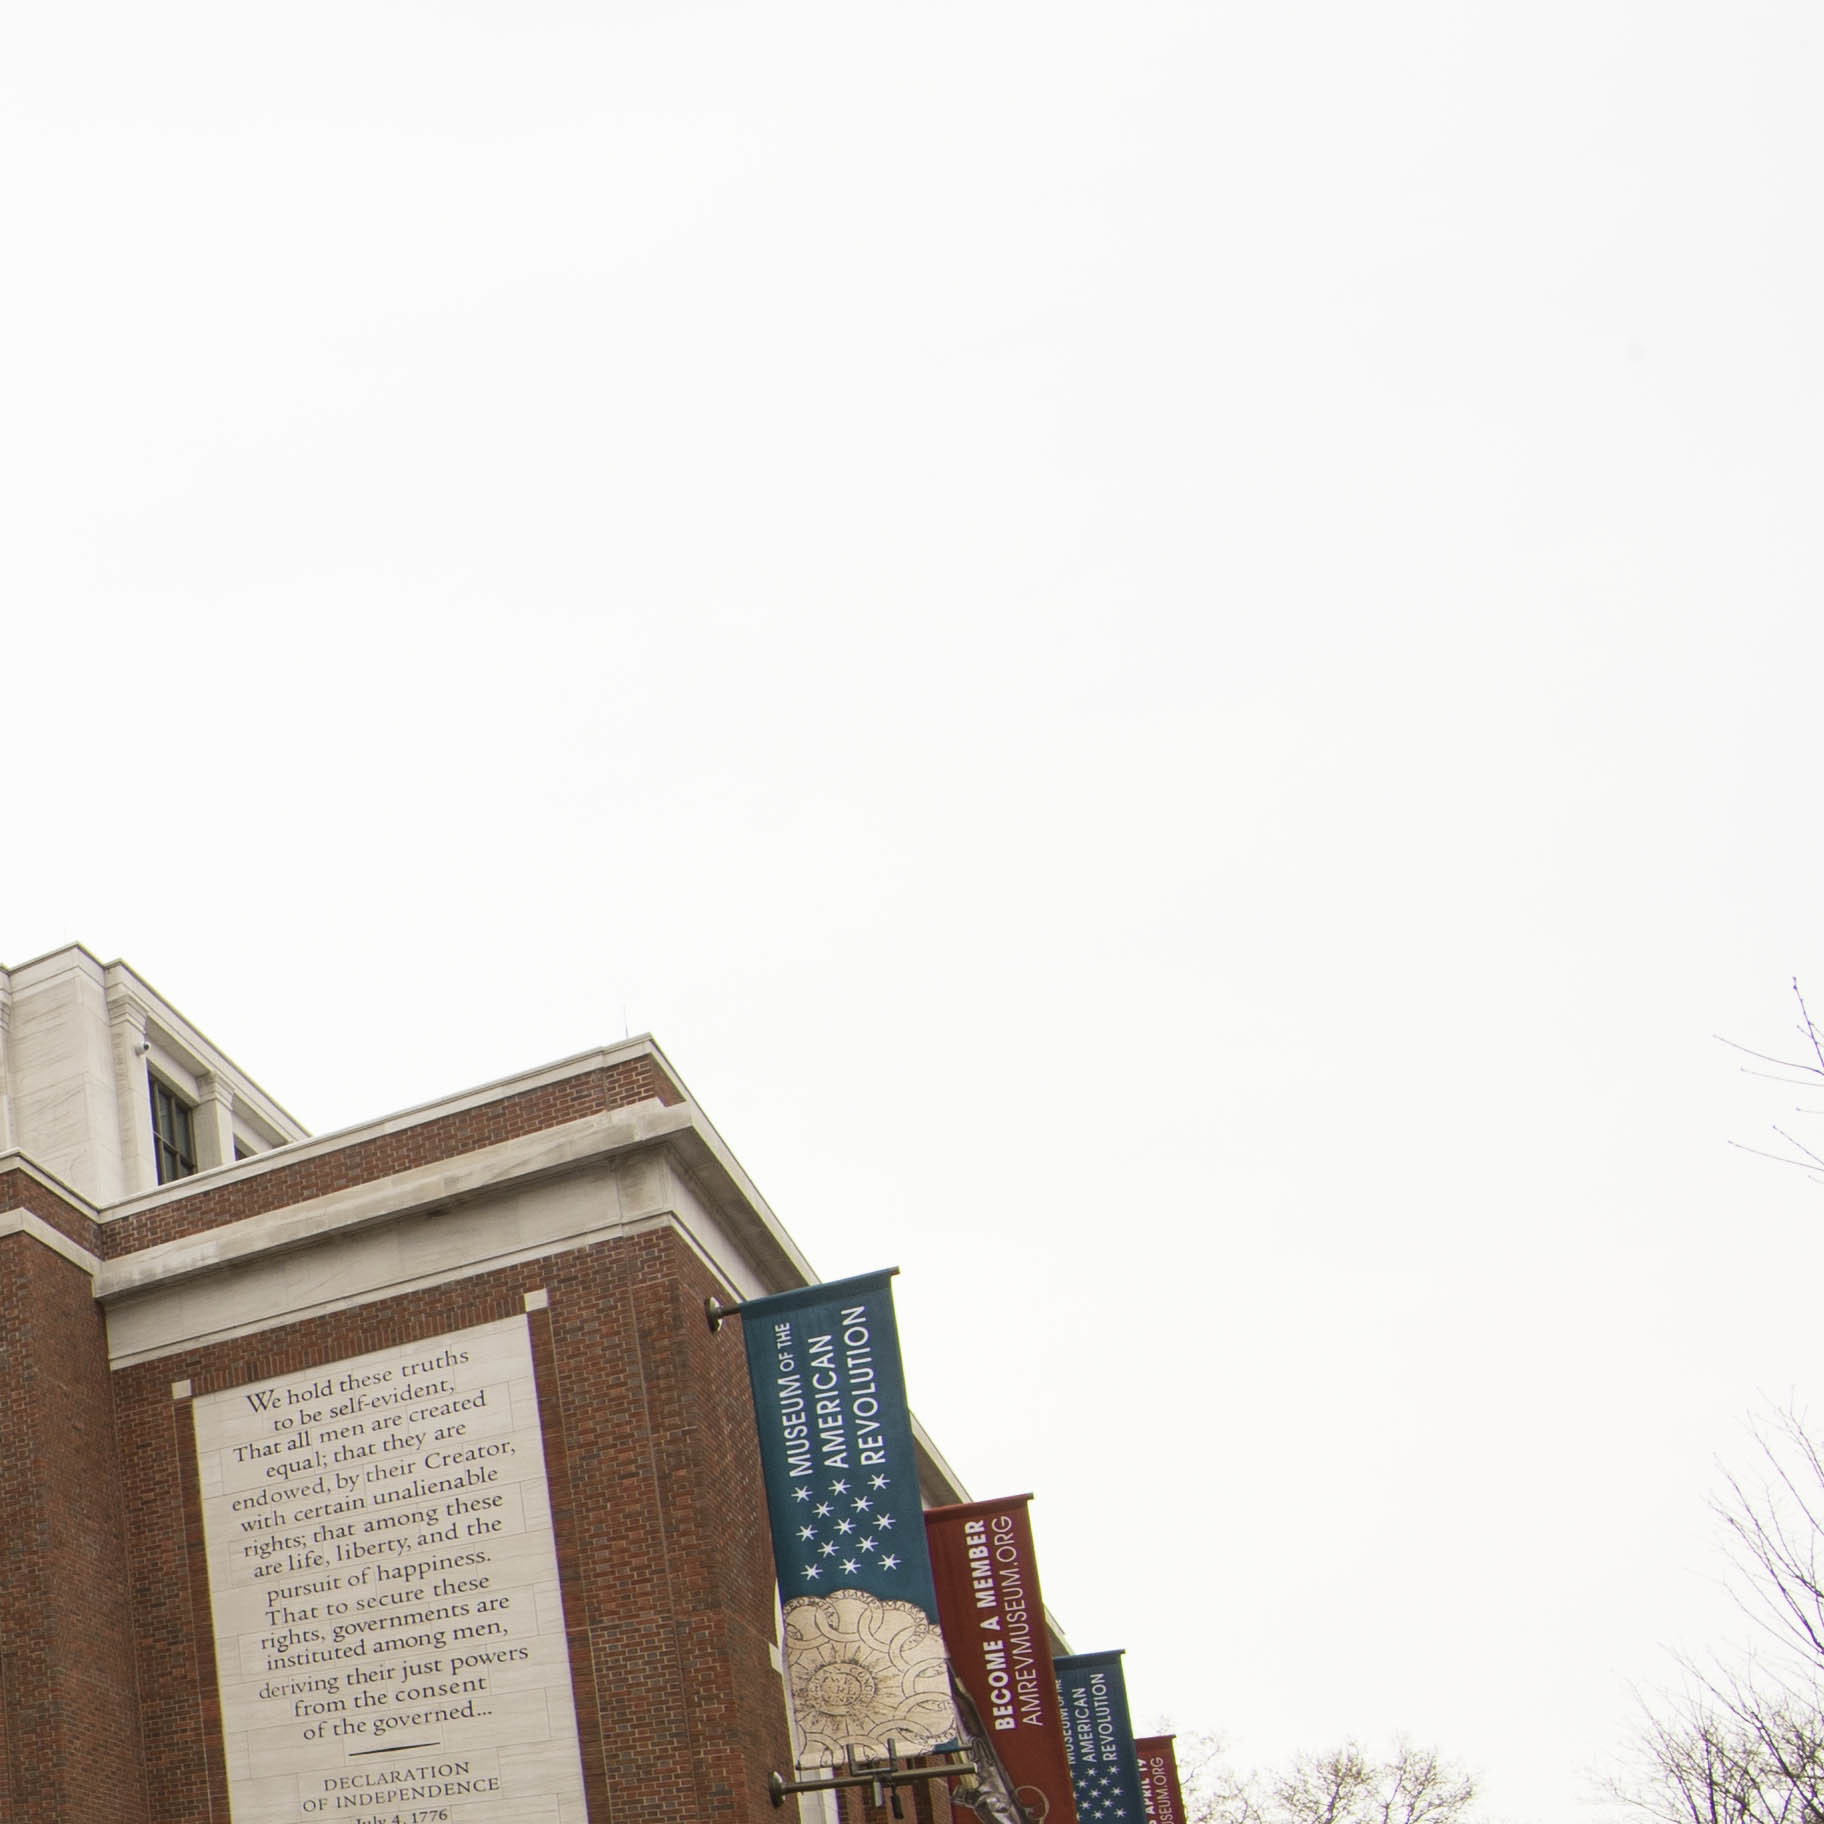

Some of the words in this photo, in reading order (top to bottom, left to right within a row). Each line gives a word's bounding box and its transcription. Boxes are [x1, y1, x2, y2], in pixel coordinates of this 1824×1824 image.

[775, 1321, 793, 1348] THE
[779, 1346, 796, 1372] OF
[246, 1390, 281, 1414] We
[287, 1378, 334, 1407] hold
[339, 1367, 393, 1393] these
[401, 1348, 469, 1377] truths
[274, 1415, 295, 1432] to
[299, 1407, 323, 1427] be
[329, 1379, 455, 1419] self-evident,
[808, 1333, 849, 1469] AMERICAN
[842, 1305, 886, 1465] REVOLUTION
[234, 1440, 282, 1463] That
[287, 1431, 312, 1452] all
[320, 1424, 366, 1446] men
[371, 1417, 403, 1436] are
[409, 1391, 486, 1424] created
[266, 1452, 328, 1481] equal;
[334, 1441, 377, 1466] that
[382, 1432, 427, 1459] they
[434, 1422, 467, 1441] are
[777, 1374, 813, 1477] MUSEUM
[232, 1476, 331, 1513] endowed,
[336, 1469, 360, 1495] by
[366, 1458, 416, 1483] their
[424, 1437, 516, 1470] Creator,
[241, 1511, 285, 1533] with
[294, 1493, 366, 1523] certain
[373, 1466, 499, 1506] unalienable
[243, 1531, 307, 1559] rights;
[313, 1519, 356, 1544] that
[363, 1505, 439, 1536] among
[446, 1492, 504, 1517] these
[253, 1558, 283, 1579] are
[288, 1549, 330, 1574] life,
[336, 1534, 412, 1566] liberty,
[417, 1523, 460, 1547] and
[466, 1516, 503, 1537] the
[267, 1575, 342, 1606] pursuit
[347, 1565, 371, 1587] of
[377, 1551, 492, 1588] happiness.
[965, 1519, 998, 1609] MEMBER
[265, 1603, 320, 1627] That
[327, 1596, 349, 1615] to
[356, 1587, 425, 1612] secure
[433, 1573, 491, 1597] these
[332, 1599, 471, 1644] governments
[477, 1594, 511, 1612] are
[983, 1615, 1001, 1631] A
[992, 1515, 1044, 1727] AMREVMUSEUM.ORG
[258, 1673, 339, 1700] deriving
[346, 1665, 397, 1687] their
[401, 1656, 443, 1684] just
[450, 1644, 529, 1677] powers
[266, 1638, 367, 1671] instituted
[373, 1628, 447, 1655] among
[453, 1619, 508, 1641] men,
[294, 1696, 346, 1718] from
[354, 1687, 388, 1709] the
[395, 1675, 486, 1703] consent
[983, 1636, 1016, 1731] BECOME
[303, 1721, 328, 1741] of
[334, 1715, 367, 1737] the
[373, 1699, 493, 1736] governed...
[1072, 1688, 1098, 1763] AMERICAN
[1090, 1673, 1118, 1761] REVOLUTION
[303, 1794, 329, 1813] OF
[335, 1776, 500, 1809] INDEPENDENCE
[323, 1760, 471, 1793] DECLARATION
[411, 1808, 448, 1824] 1776
